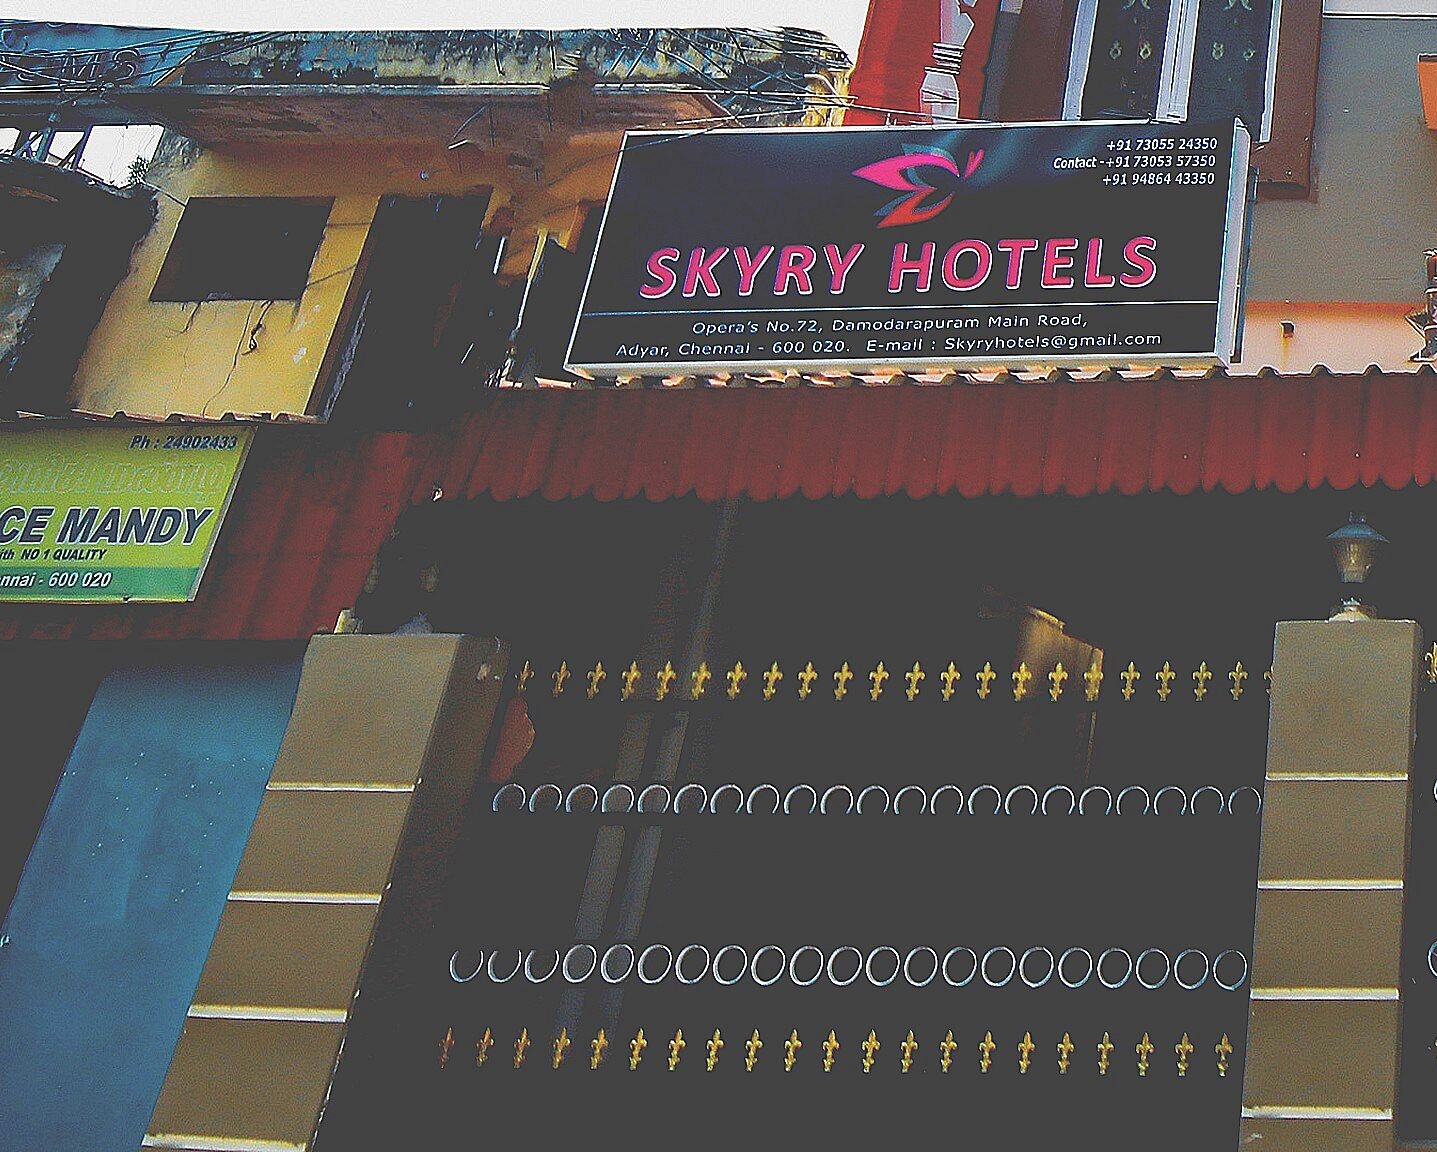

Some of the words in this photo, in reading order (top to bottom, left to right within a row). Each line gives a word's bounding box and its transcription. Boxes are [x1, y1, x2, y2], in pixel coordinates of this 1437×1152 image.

[1106, 139, 1131, 151] +91
[1135, 138, 1175, 151] 73055
[1178, 137, 1218, 150] 24350
[1053, 156, 1097, 169] Contact
[1133, 155, 1172, 167] 73053
[1175, 155, 1216, 167] 57350
[1102, 173, 1127, 185] +91
[1131, 173, 1171, 185] 94864
[1174, 172, 1215, 185] 43350
[638, 243, 866, 299] SKYRY
[886, 235, 1158, 291] HOTELS
[766, 319, 823, 334] No.72,
[832, 316, 980, 332] Damodarapuram
[987, 315, 1030, 328] Main
[1037, 314, 1089, 328] Road,
[615, 342, 670, 358] Adyar,
[678, 341, 750, 356] Chennai
[772, 341, 805, 354] 600
[944, 333, 1162, 351] Skyryhotels@gmail.com
[129, 434, 150, 449] Ph
[56, 505, 215, 546] MANDY
[20, 549, 40, 560] NO
[43, 549, 51, 560] 1
[53, 549, 107, 561] QUALITY
[0, 572, 37, 587] nnai
[48, 572, 79, 587] 600
[82, 572, 112, 588] 020
